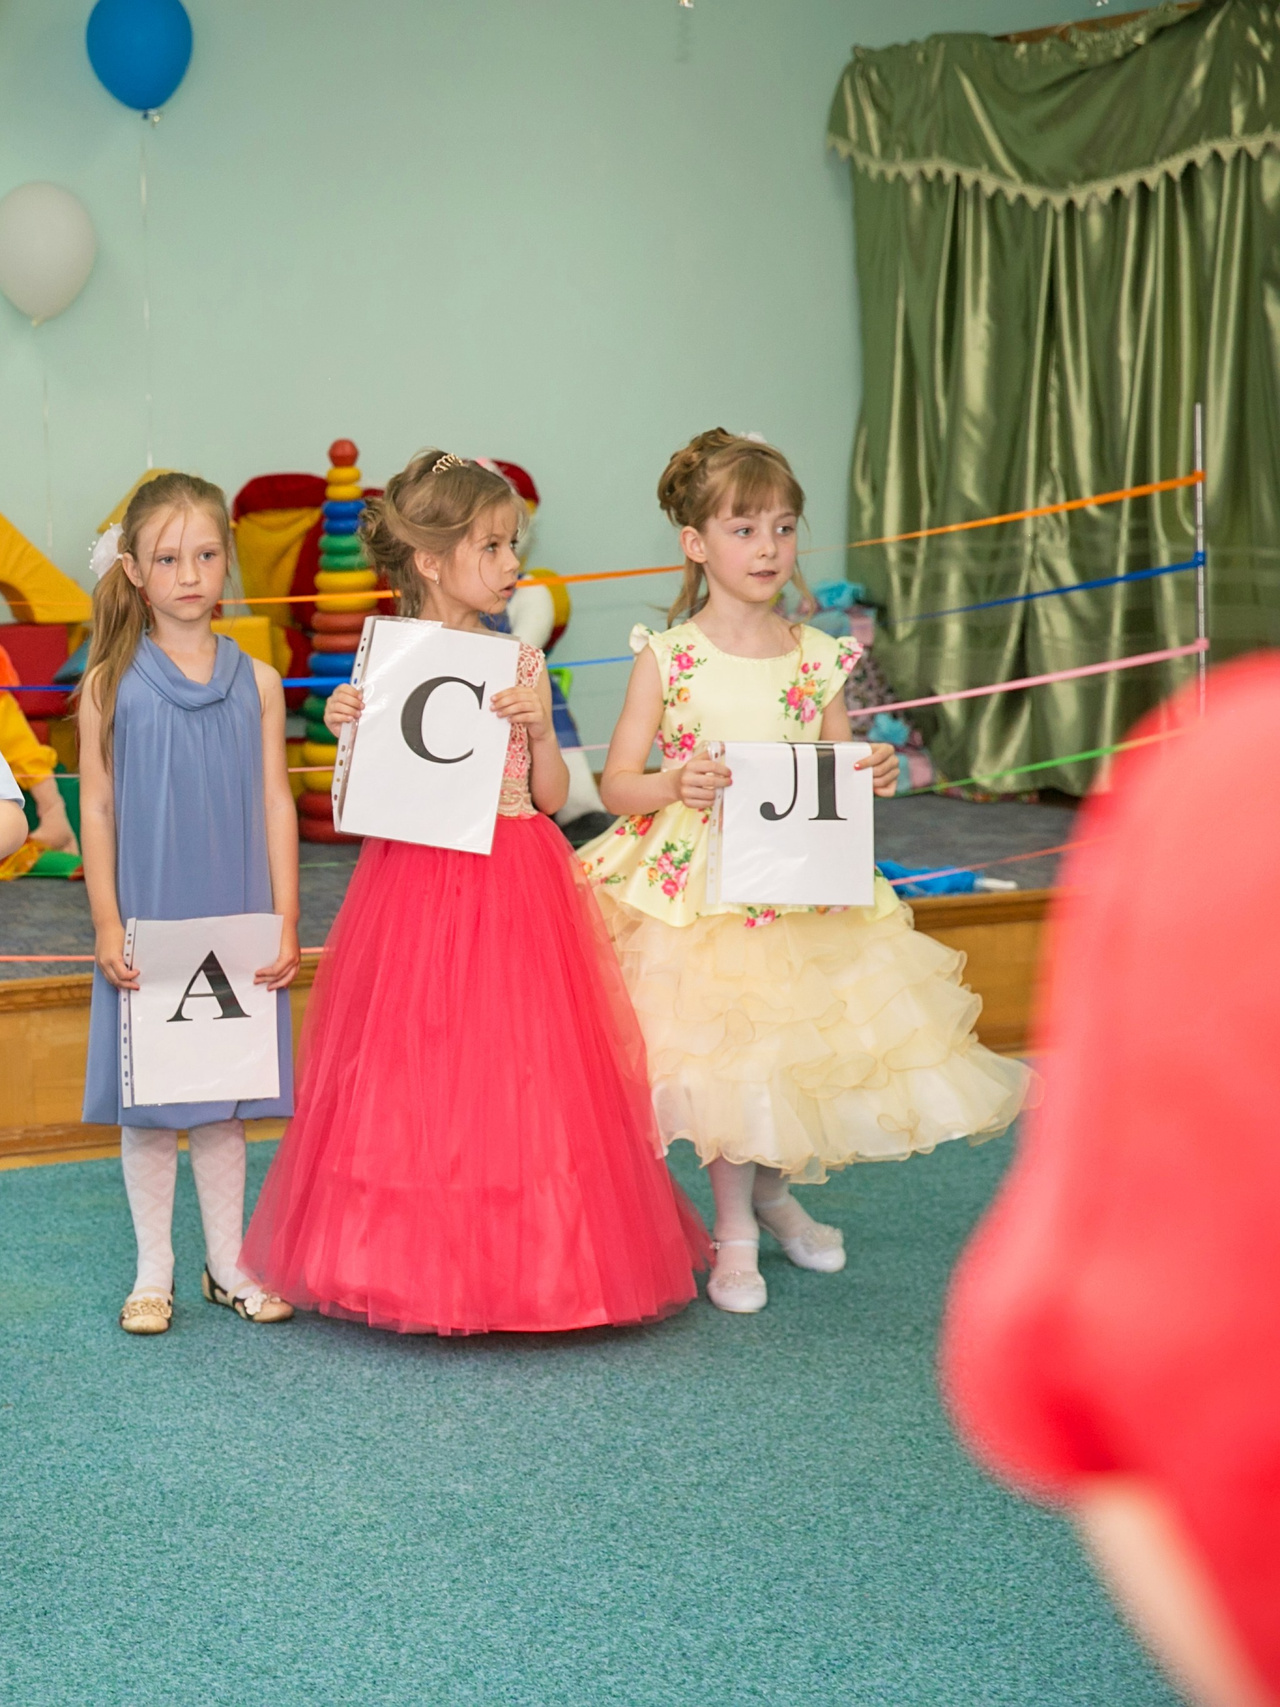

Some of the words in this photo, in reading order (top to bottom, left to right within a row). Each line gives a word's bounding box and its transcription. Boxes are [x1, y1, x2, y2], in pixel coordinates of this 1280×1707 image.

[401, 676, 486, 764] С
[759, 743, 848, 821] Л
[166, 950, 251, 1023] А
